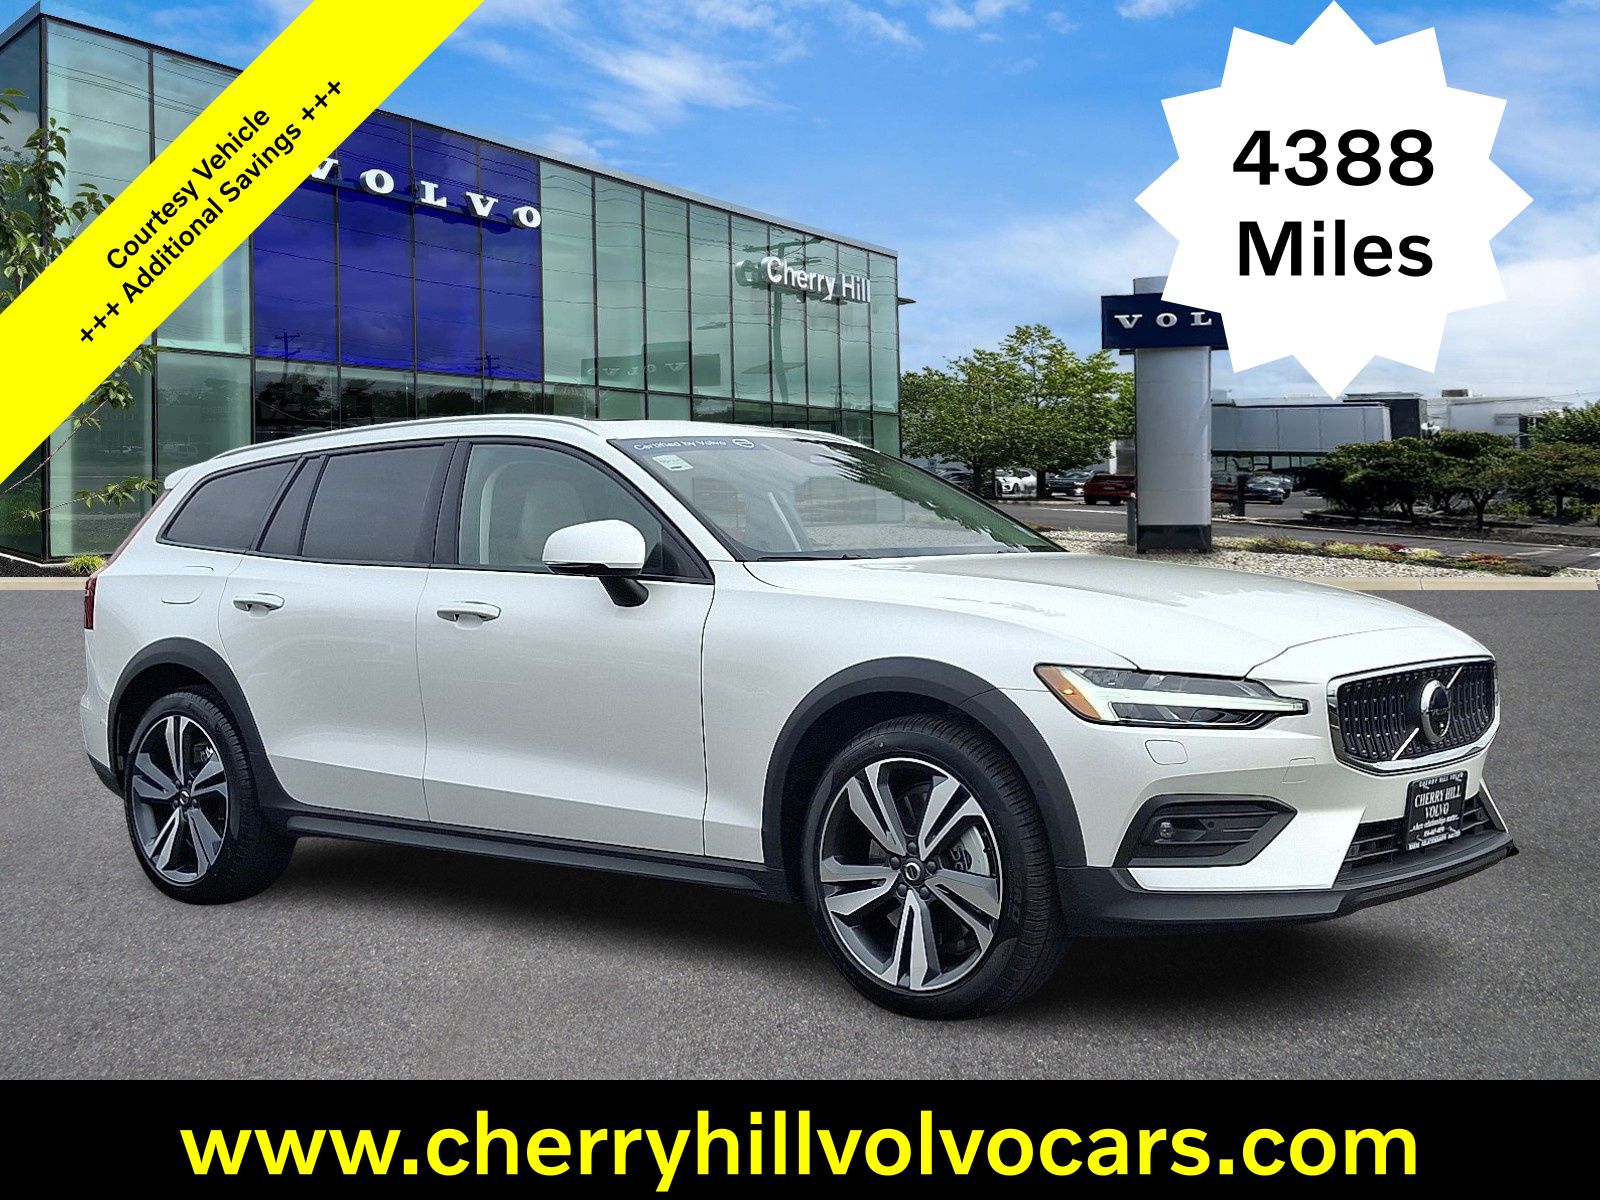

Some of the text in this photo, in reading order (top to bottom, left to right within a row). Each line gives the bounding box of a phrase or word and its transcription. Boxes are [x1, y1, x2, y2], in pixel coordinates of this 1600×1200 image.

[309, 157, 542, 229] VOLVO
[762, 256, 871, 303] Cherry Hill
[1114, 311, 1213, 329] VOL
[1414, 784, 1462, 808] CHERRY HILL
[1425, 802, 1450, 819] VOLVO
